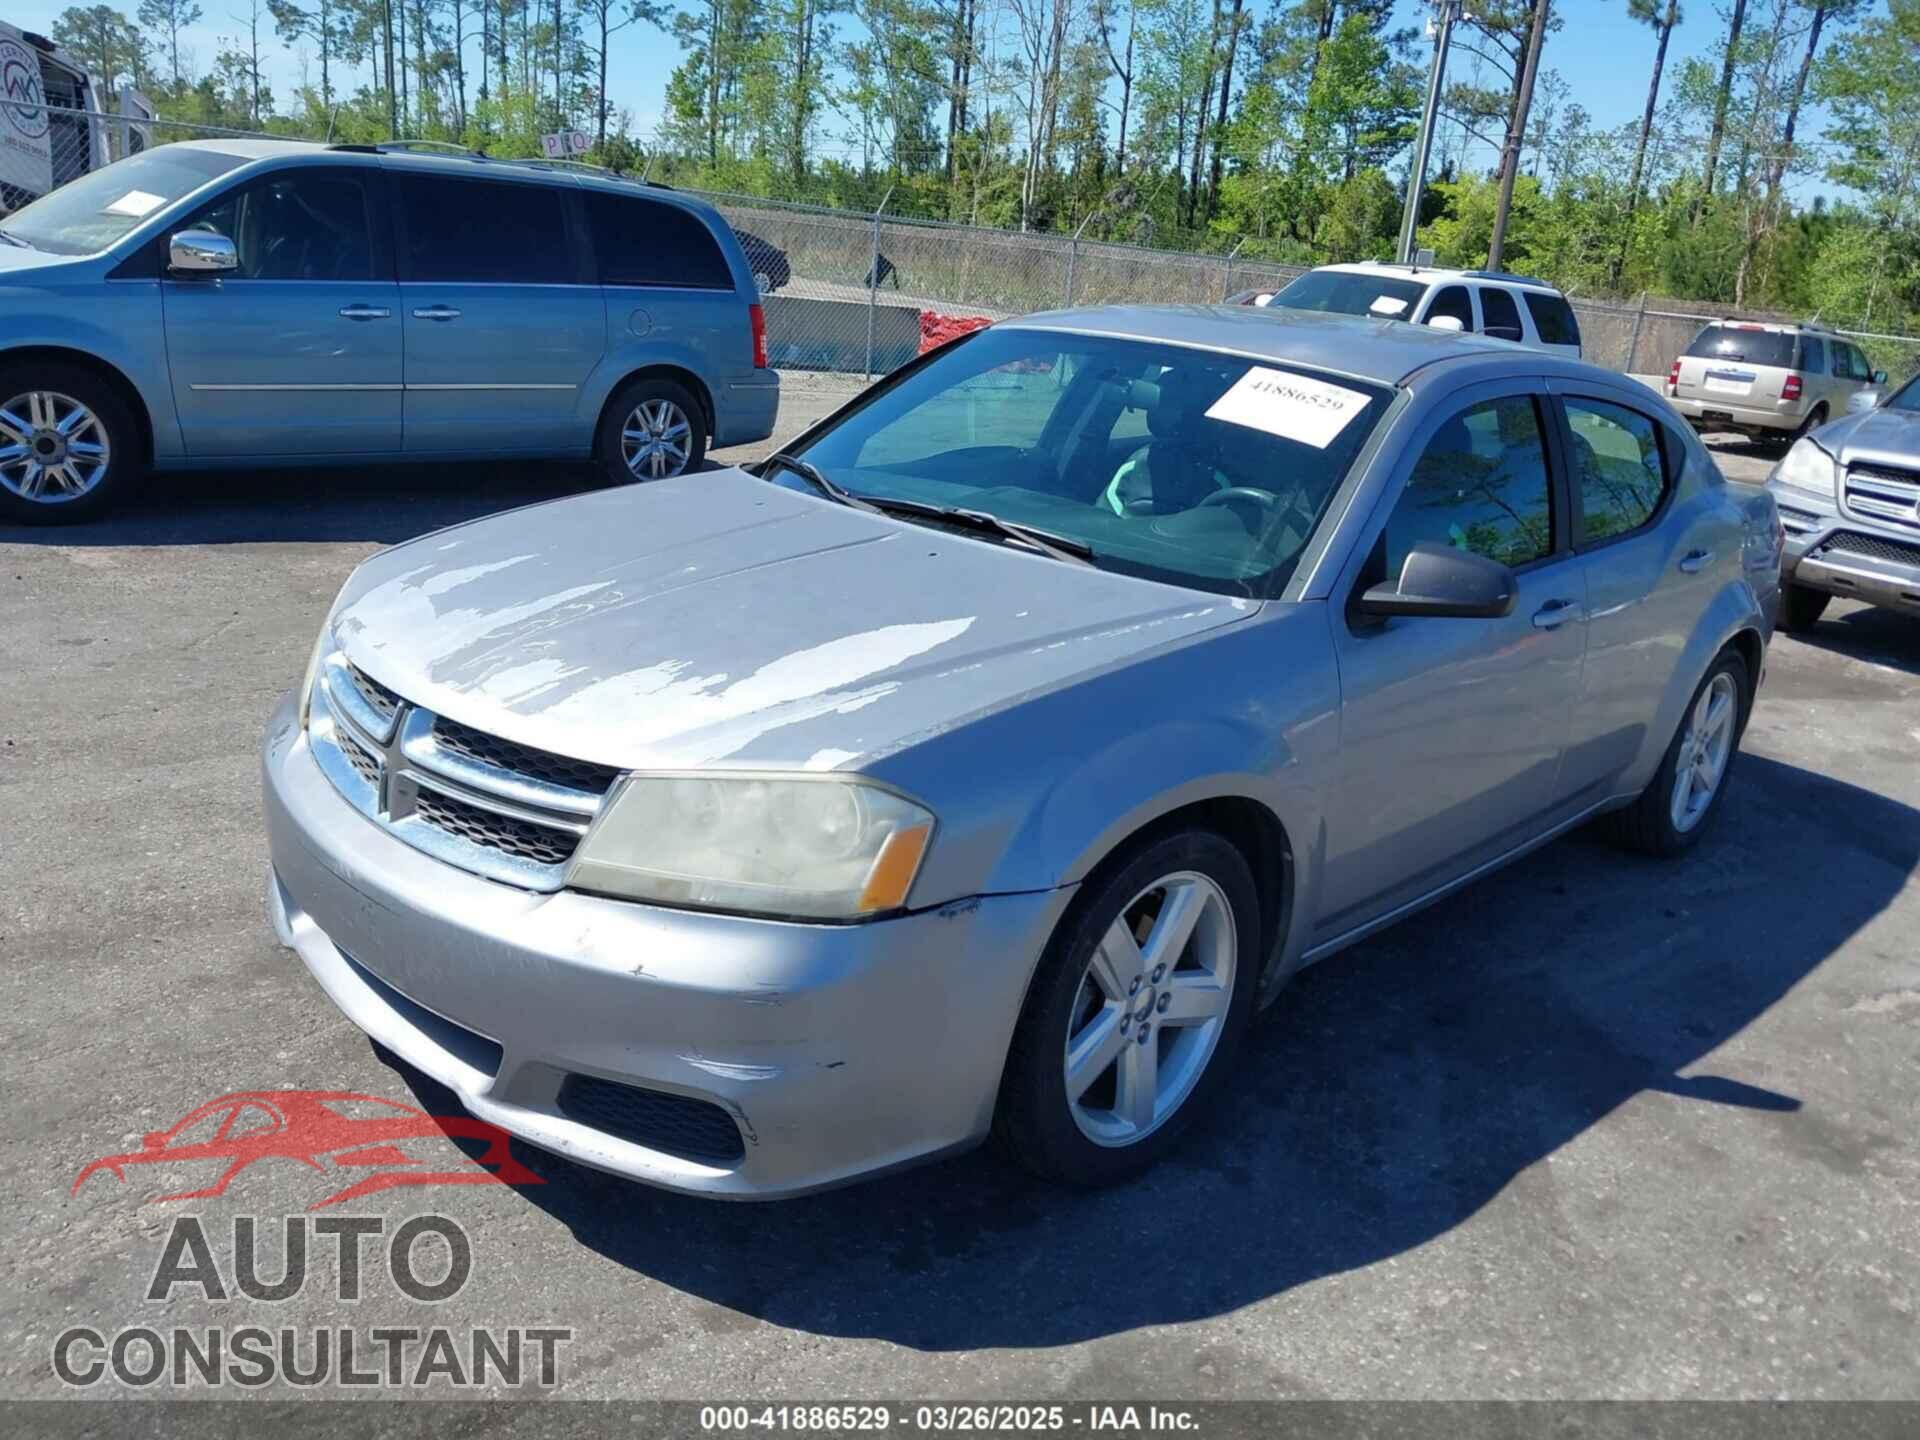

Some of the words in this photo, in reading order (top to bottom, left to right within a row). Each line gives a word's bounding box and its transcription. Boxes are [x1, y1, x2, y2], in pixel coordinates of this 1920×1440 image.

[547, 136, 557, 154] P
[572, 132, 588, 150] Q
[1250, 380, 1345, 411] 41886529
